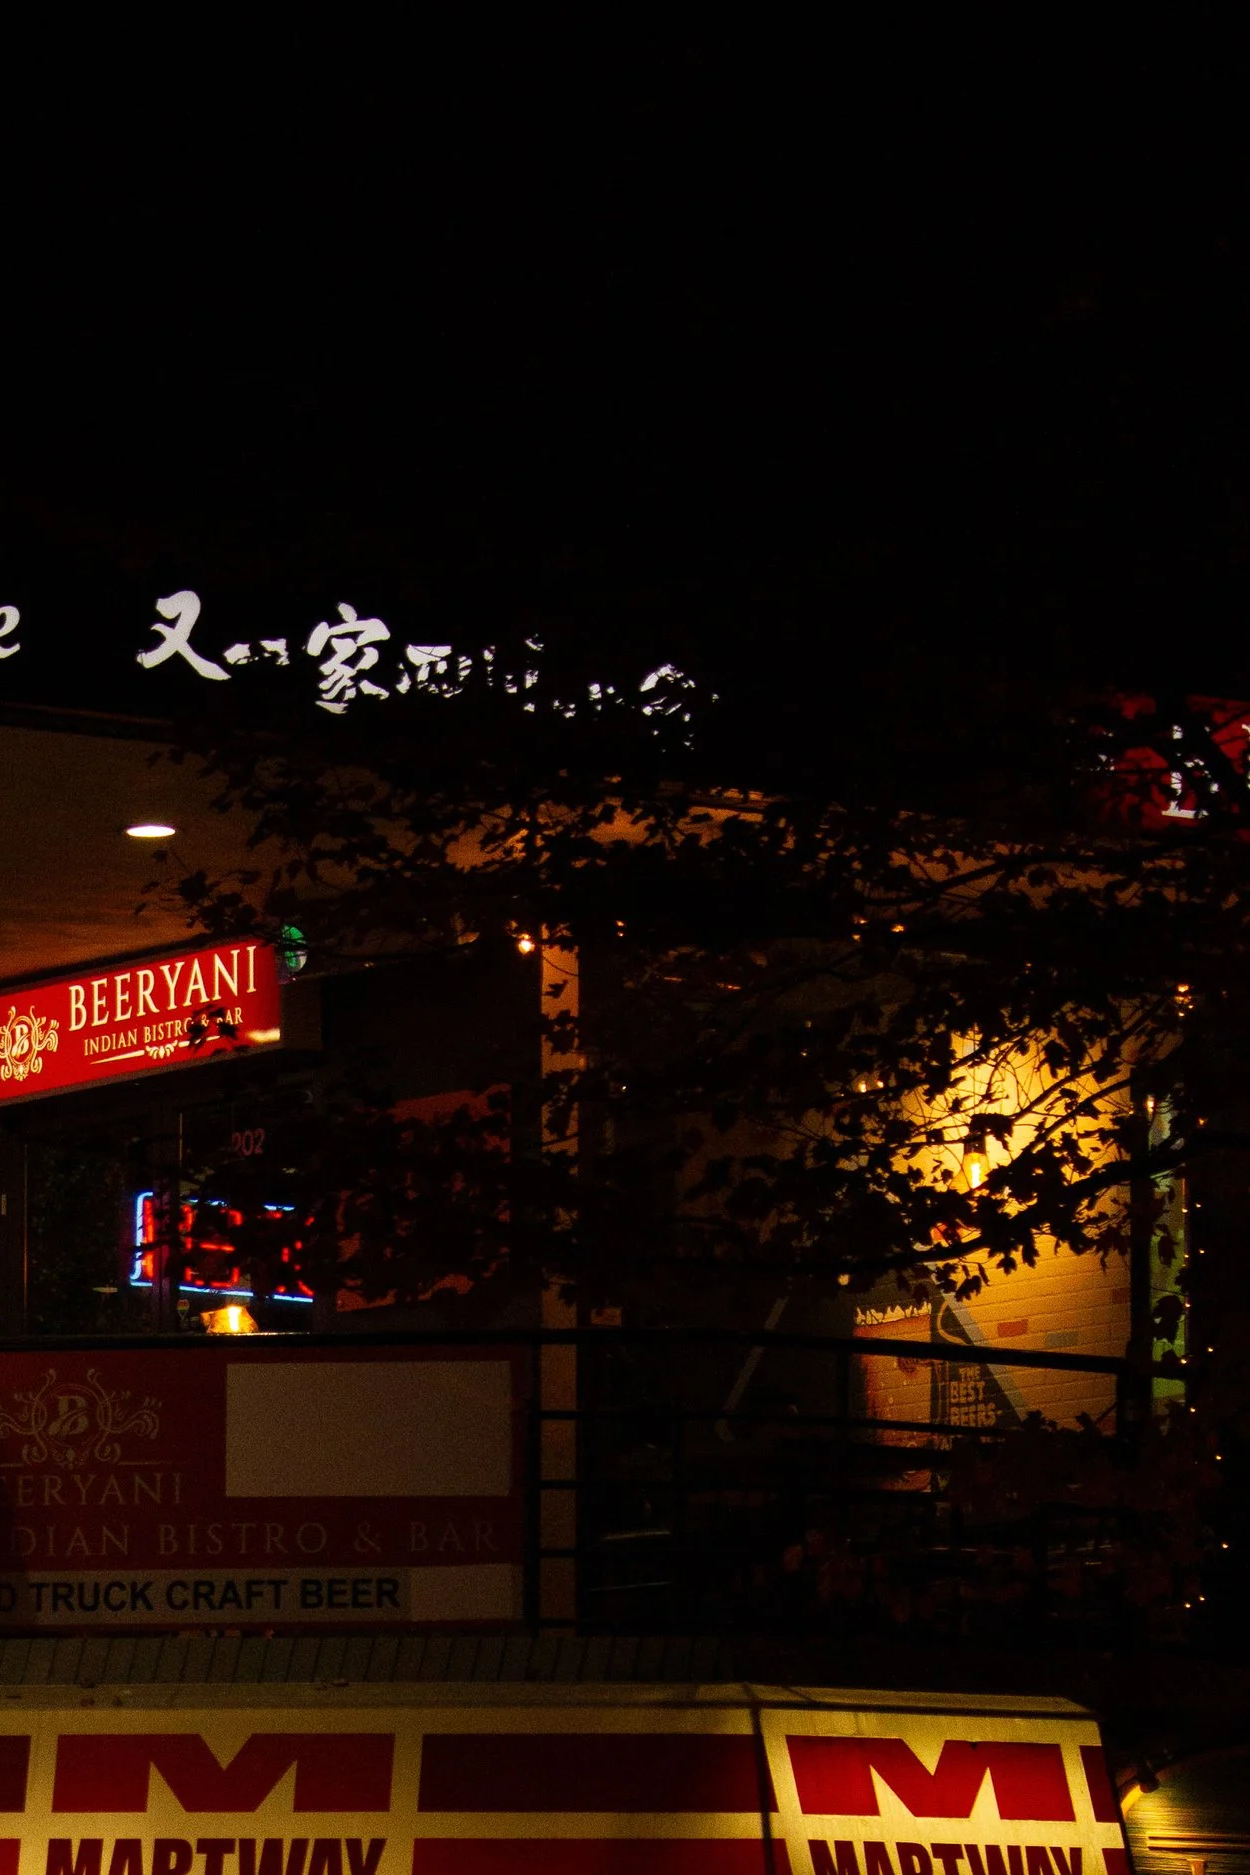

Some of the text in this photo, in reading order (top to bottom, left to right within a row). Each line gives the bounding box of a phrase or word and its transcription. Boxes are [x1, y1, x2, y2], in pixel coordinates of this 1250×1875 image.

[68, 945, 257, 1032] BEERYANI
[84, 1028, 138, 1056] INDIAN
[950, 1381, 986, 1403] BEST
[158, 1520, 330, 1557] BISTRO
[352, 1523, 383, 1553] &
[408, 1519, 502, 1553] BAR
[29, 1580, 154, 1613] TRUCK
[166, 1579, 285, 1611] CRAFT
[300, 1577, 401, 1610] BEER
